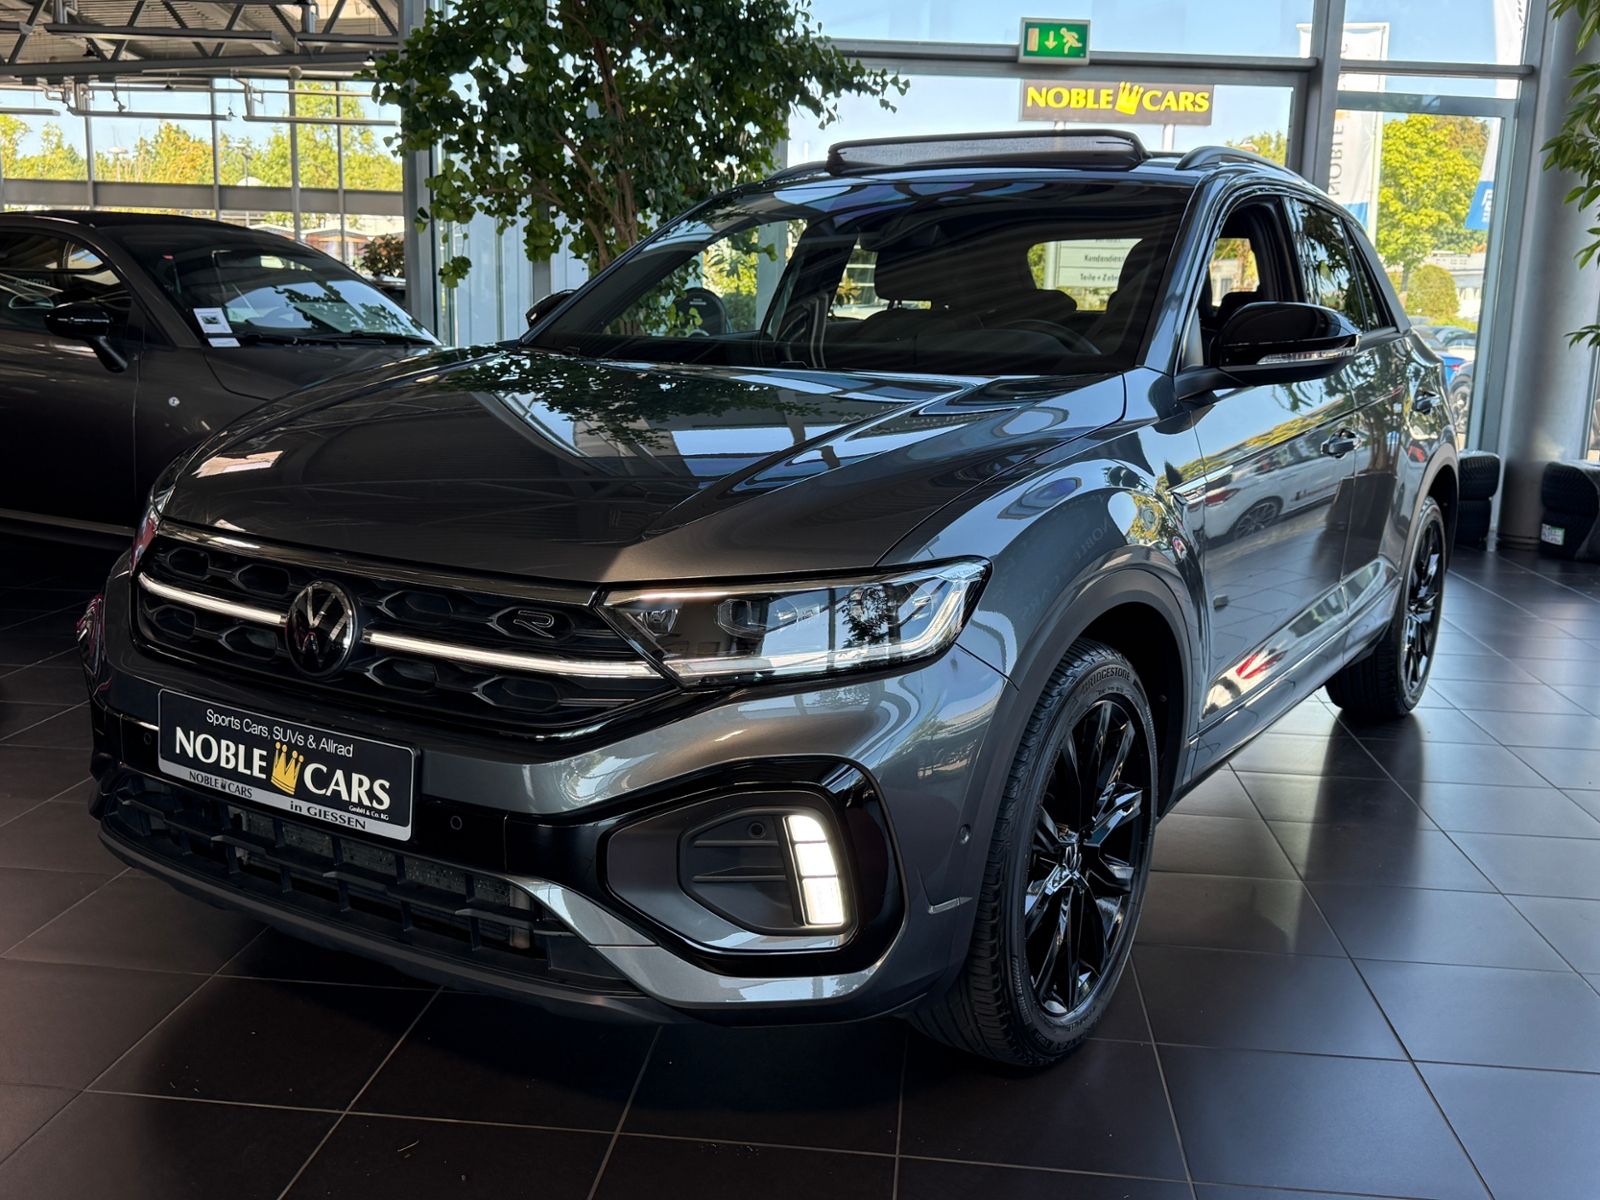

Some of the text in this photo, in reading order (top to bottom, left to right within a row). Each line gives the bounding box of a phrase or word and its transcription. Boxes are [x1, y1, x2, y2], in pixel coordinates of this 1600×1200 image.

[1026, 86, 1210, 113] NOBLE CARS
[206, 708, 354, 758] Sports Cars, SUVs & Allrad
[175, 726, 391, 811] NOBLE CARS
[189, 770, 253, 799] NOBLE CARS
[290, 800, 366, 830] in GIESSEN
[348, 804, 366, 815] GmbH
